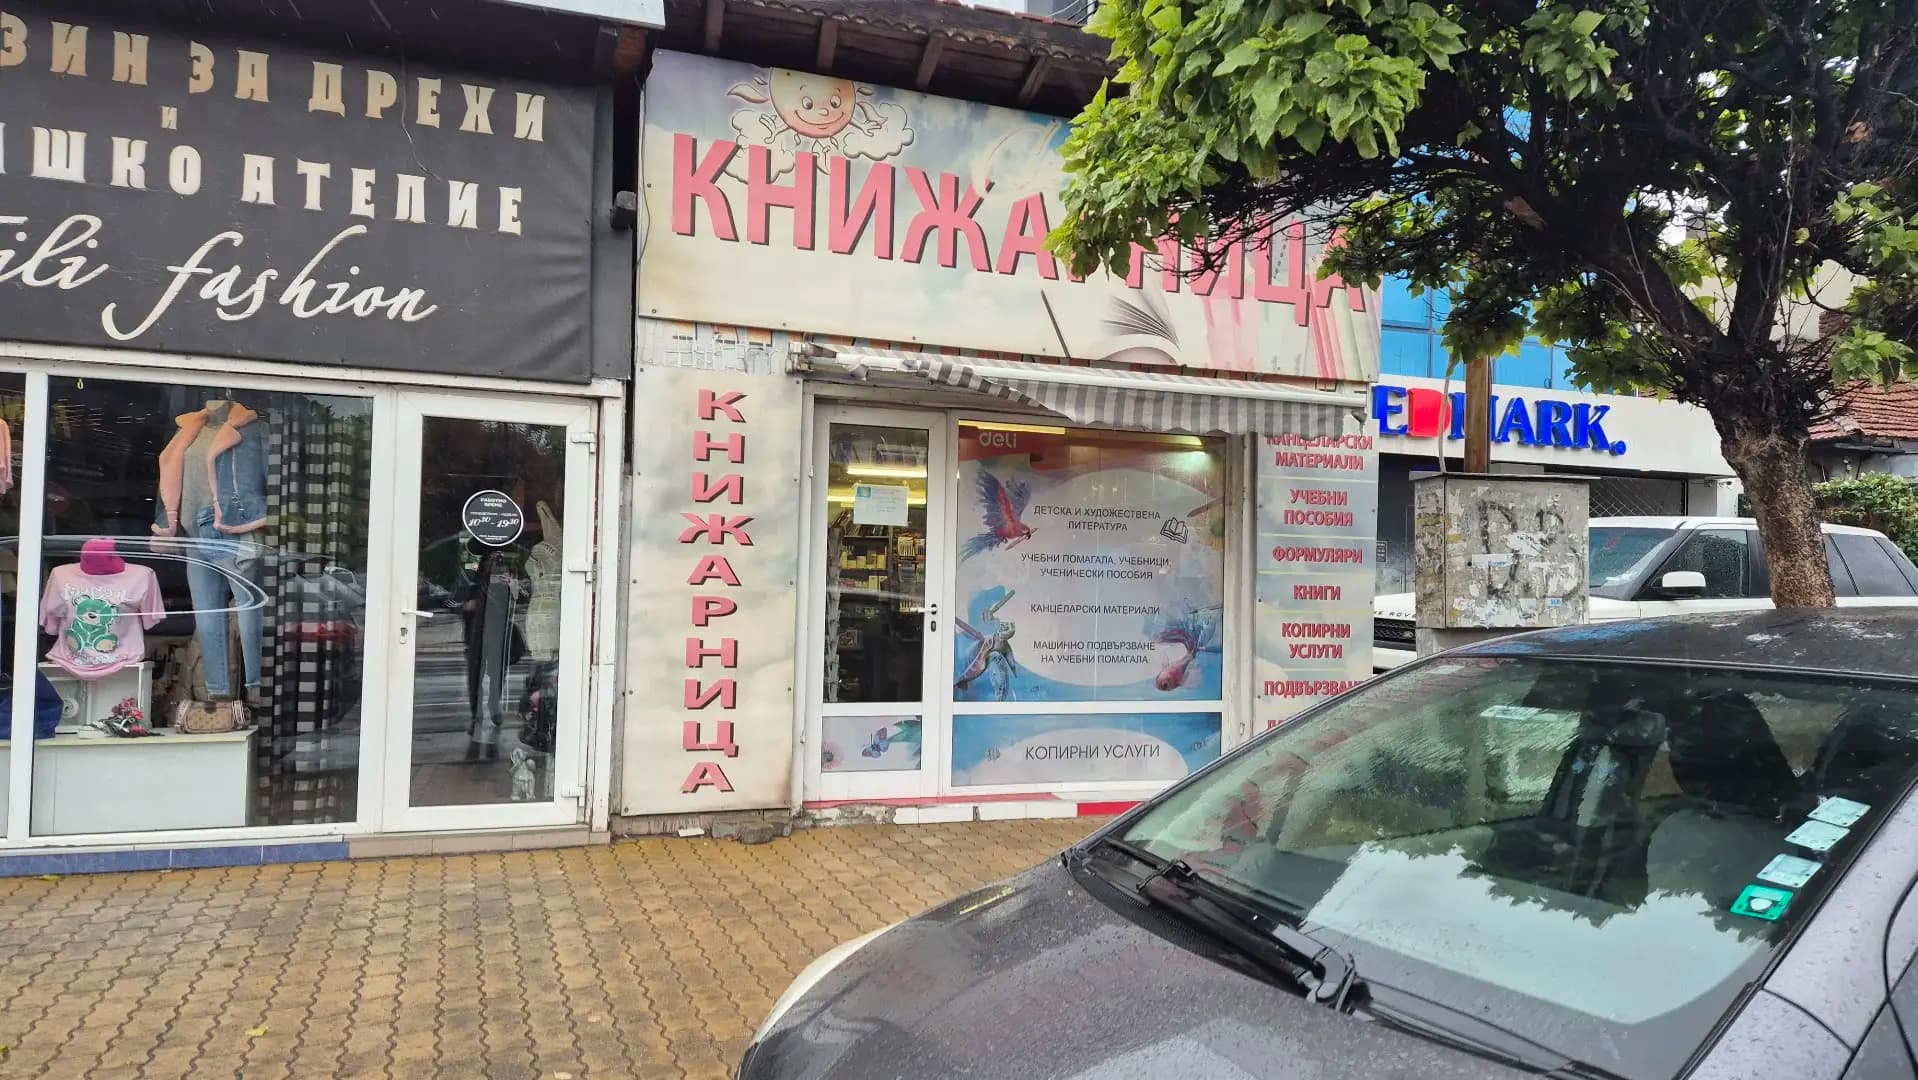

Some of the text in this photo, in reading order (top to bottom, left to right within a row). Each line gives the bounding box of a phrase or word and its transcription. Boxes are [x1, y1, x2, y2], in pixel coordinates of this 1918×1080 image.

[189, 41, 270, 102] ЗА
[308, 61, 545, 142] ДРЕХИ
[0, 122, 201, 195] ШКО
[671, 133, 1366, 327] КНИЖАНИЦА
[101, 224, 438, 341] fashion
[979, 431, 1017, 449] deli
[1275, 451, 1364, 470] МАТЕРИАЛИ
[1289, 489, 1348, 506] УЧЕБНИ
[1033, 504, 1161, 520] ДЕТСКА И ХУДОЖЕСТВЕНА
[1284, 509, 1353, 526] ПОСОБИЯ
[1068, 521, 1128, 532] ЛИТЕРАТУРА
[1021, 553, 1060, 563] УЧЕБНИ
[1272, 545, 1363, 563] ФОРМУЛЯРИ
[1040, 568, 1153, 580] УЧЕНИЧЕСКИ ПОСОБИЯ
[677, 388, 755, 793] КНИЖАРНИЦА
[1293, 585, 1341, 601] КНИГИ
[1030, 603, 1160, 615] КАНЦЕЛАРСКИ МАТЕРИАЛИ
[1281, 622, 1351, 639] КОПИРНИ
[1033, 640, 1155, 652] МАШИННО ПОДВЪРЗВАНЕ
[1289, 643, 1343, 660] УСЛУГИ
[1041, 655, 1149, 665] НА УЧЕБНИ ПОМАГАЛА
[1263, 680, 1362, 698] ПОДВЪРЗВА
[1025, 744, 1160, 761] КОПИРНИ УСЛУГИ
